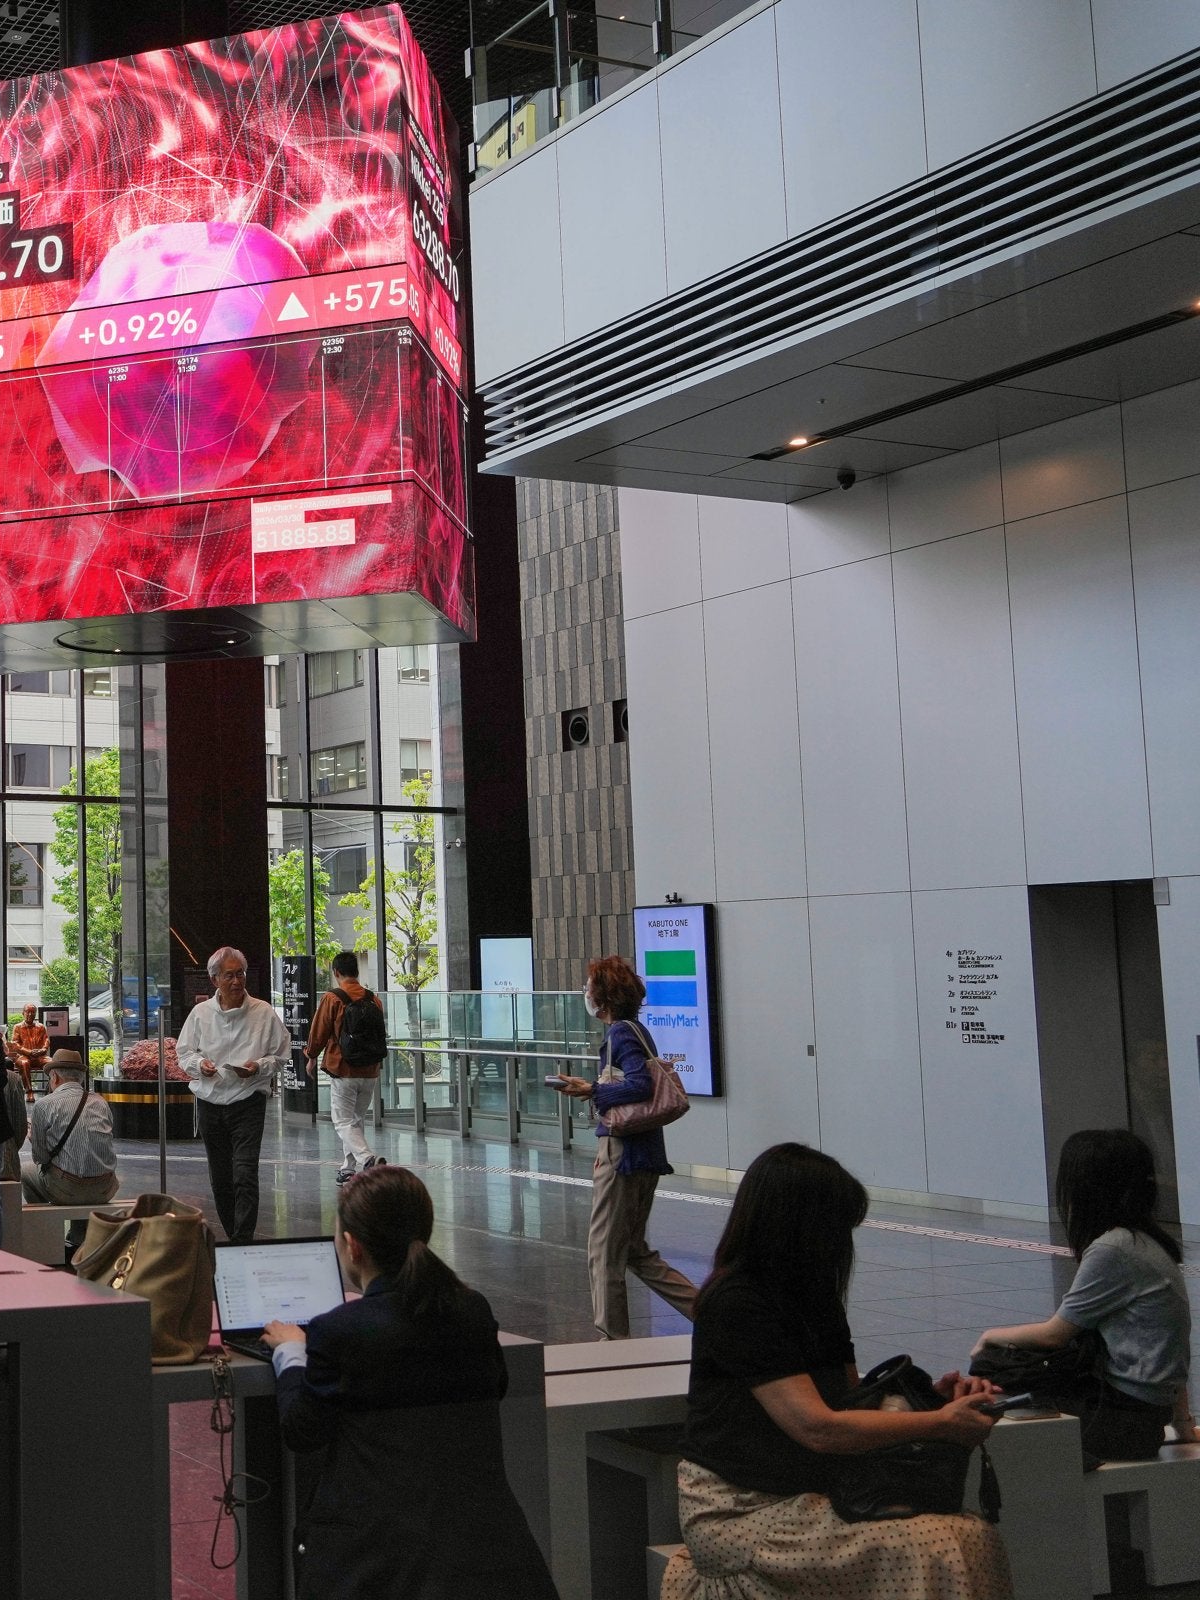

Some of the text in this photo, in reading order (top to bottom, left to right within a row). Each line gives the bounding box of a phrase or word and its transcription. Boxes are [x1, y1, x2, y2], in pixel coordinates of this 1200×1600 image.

[432, 188, 444, 226] 225
[413, 200, 460, 302] 63288.70
[79, 307, 197, 345] +0.92%
[322, 346, 342, 354] 12:30
[434, 326, 460, 376] +0.92%
[109, 374, 126, 382] 11:00
[178, 365, 196, 373] 11:30
[255, 523, 351, 549] 51885.85
[648, 919, 688, 928] KABUTO ONE
[647, 1013, 699, 1028] FamilyMart
